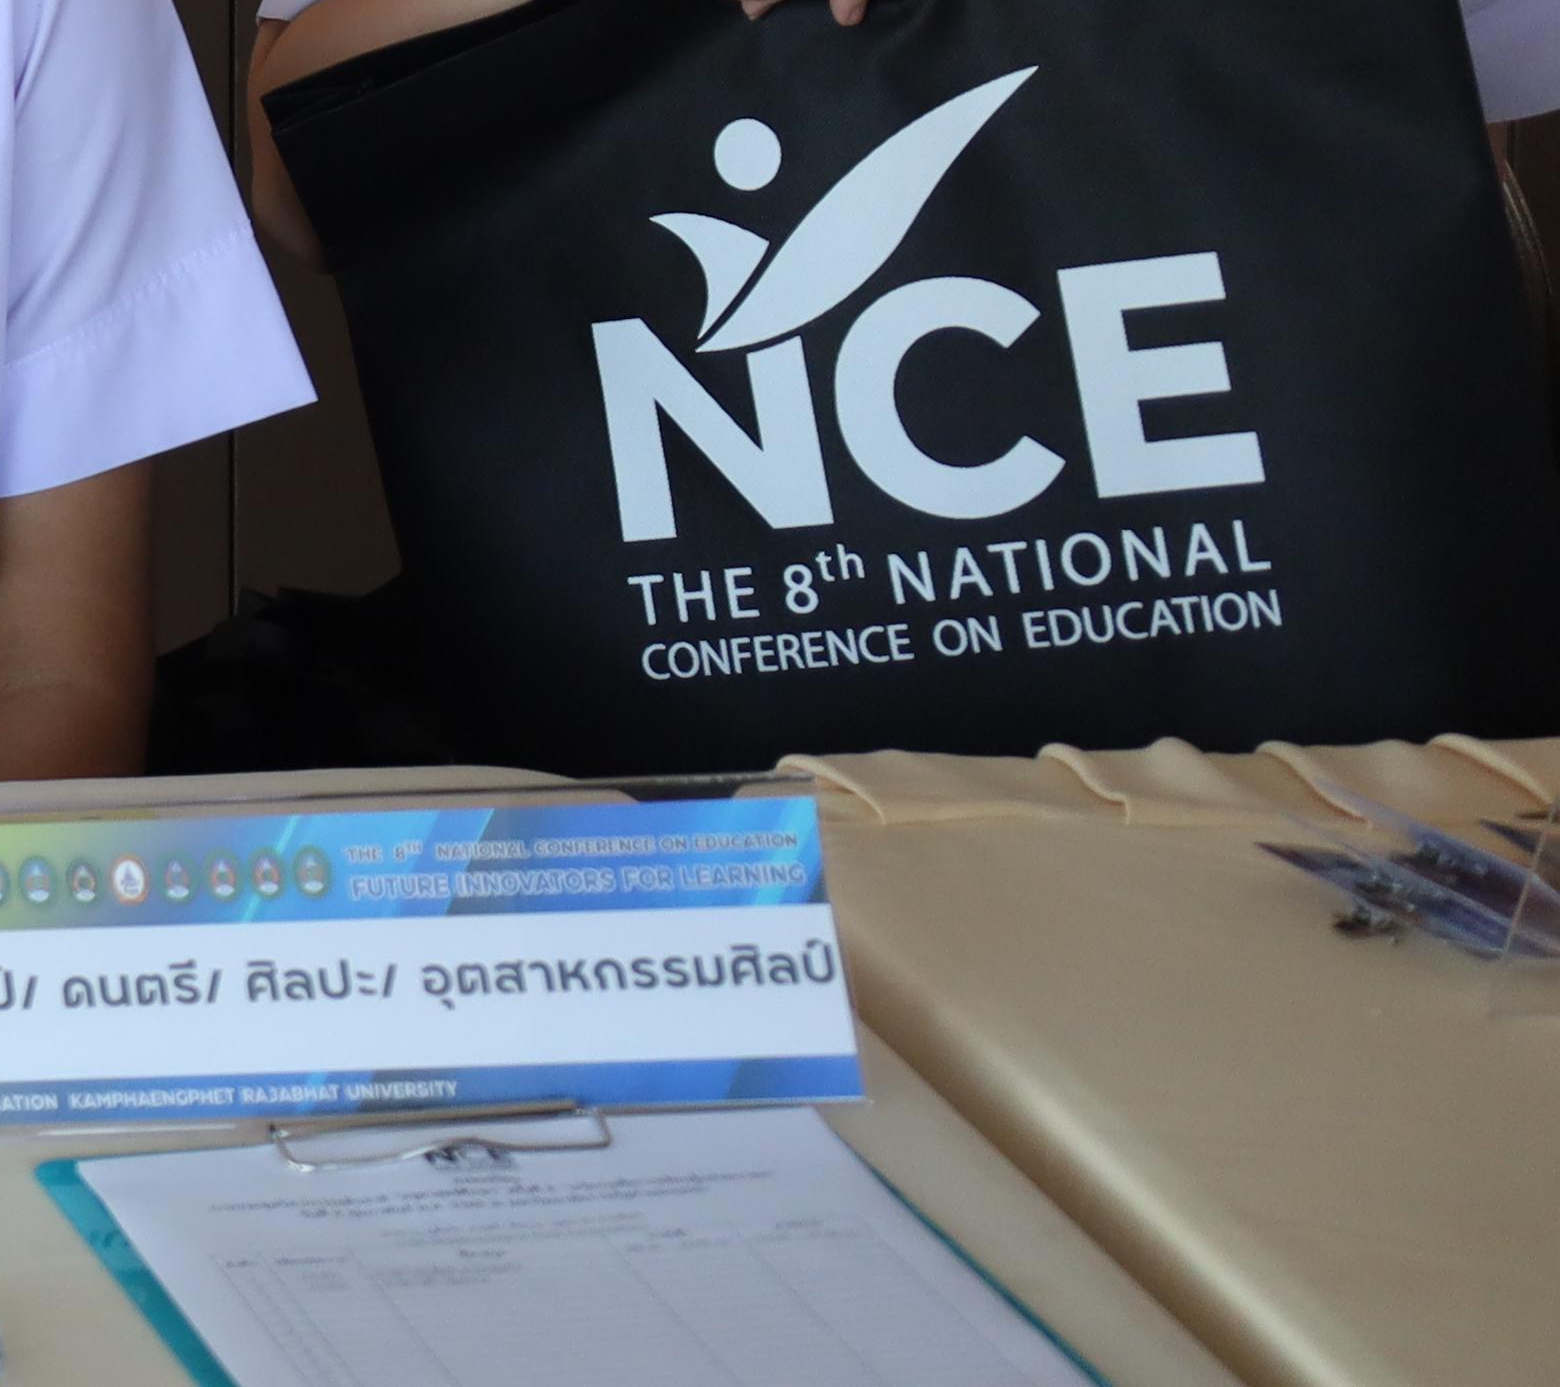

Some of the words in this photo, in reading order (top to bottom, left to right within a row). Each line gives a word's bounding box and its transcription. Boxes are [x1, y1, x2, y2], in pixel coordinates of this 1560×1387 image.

[591, 251, 1266, 543] NCE
[628, 566, 761, 627] THE
[783, 542, 866, 615] 8th
[887, 519, 1273, 605] NATIONAL
[641, 622, 915, 681] CONFERENCE
[932, 616, 1001, 658] ON
[1025, 589, 1283, 649] EDUCATION
[346, 844, 383, 863] THE
[435, 839, 531, 861] NATIONAL
[535, 835, 654, 857] CONFERENCE
[660, 833, 688, 852] ON
[694, 831, 800, 852] EDUCATION
[351, 873, 450, 901] FUTURE
[456, 866, 616, 898] INNOVATORS
[623, 865, 673, 892] FOR
[680, 862, 806, 890] LEARNING
[62, 959, 222, 1009] ดนตรี/
[246, 958, 397, 1004] ศิลปะ/
[423, 937, 836, 1011] อุตสาหกรรมศิลป์
[69, 1087, 235, 1110] KAMPHAENGPHET
[242, 1084, 339, 1105] RAJABHAT
[346, 1080, 458, 1102] UNIVERSITY
